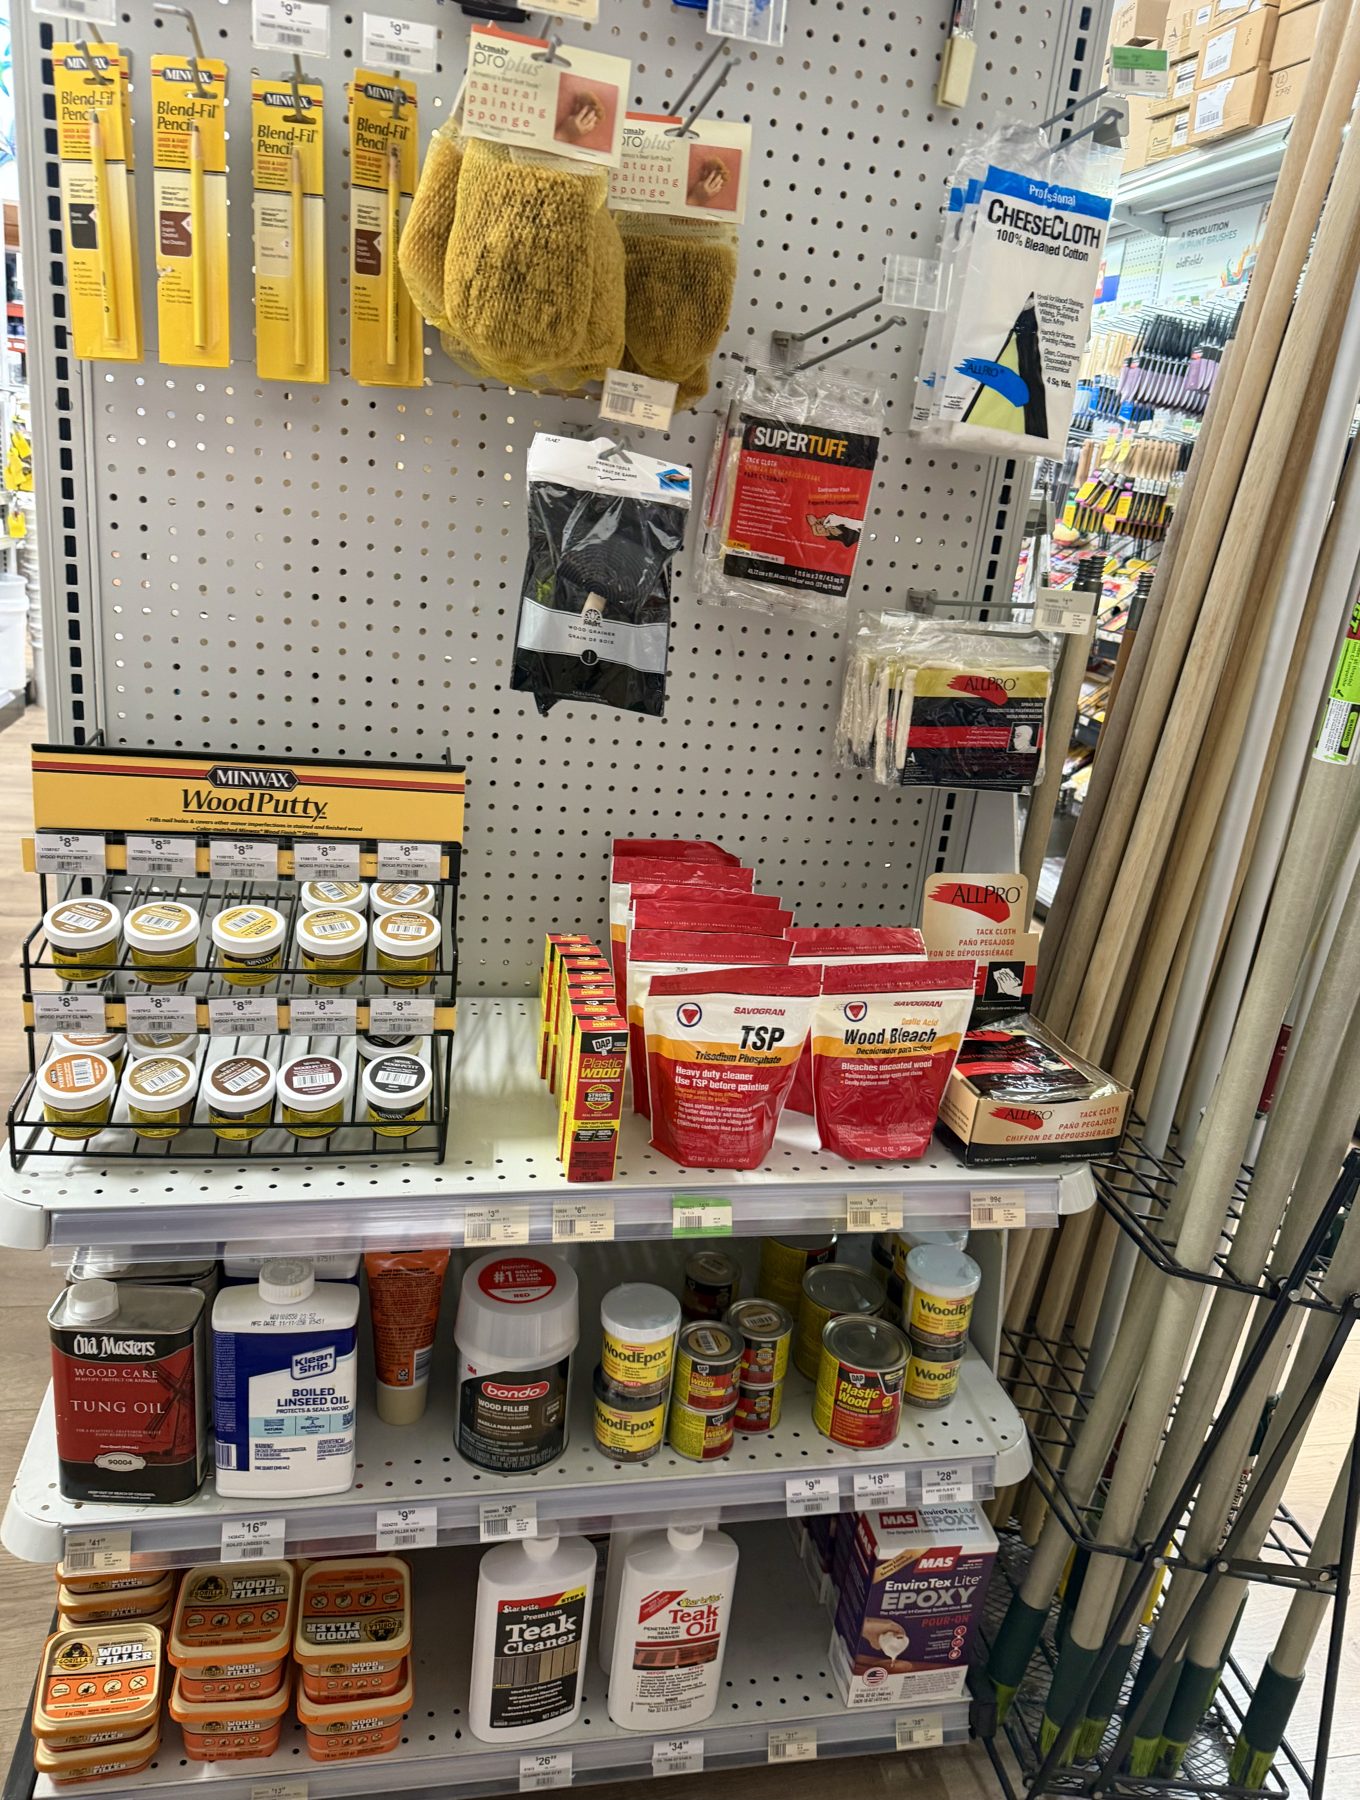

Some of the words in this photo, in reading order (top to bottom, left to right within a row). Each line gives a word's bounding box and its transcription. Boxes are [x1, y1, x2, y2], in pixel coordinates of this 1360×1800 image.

[470, 80, 537, 100] natural
[266, 93, 309, 108] MINWX
[469, 94, 546, 119] painting
[157, 101, 215, 119] Blend-Fil
[467, 108, 530, 128] sponge
[257, 125, 315, 143] Blend-Fil
[357, 118, 407, 140] Blend-Fil
[612, 172, 679, 188] painting
[611, 186, 665, 198] sponge
[753, 427, 848, 460] SUPERTUFF
[216, 770, 290, 788] MINWAX
[951, 885, 1021, 904] ALLPRO
[976, 928, 994, 936] TACK
[996, 928, 1016, 936] CLOTH
[959, 937, 978, 946] PAÑO
[980, 938, 1015, 947] PEGAJOSO
[894, 1000, 942, 1008] SAVOGRAN
[733, 1006, 786, 1016] SAVOGRAN
[739, 1026, 784, 1051] TSP
[844, 1028, 886, 1045] Wood
[889, 1028, 937, 1044] Bleach
[595, 1039, 611, 1050] DAP
[582, 1058, 624, 1069] Plastic
[695, 1051, 736, 1062] Trisodium
[738, 1054, 781, 1066] Phosphate
[842, 1062, 878, 1071] Bleaches
[879, 1062, 912, 1071] uncoated
[914, 1060, 932, 1068] wood
[581, 1068, 621, 1078] WOOD
[676, 1066, 700, 1078] Heavy
[702, 1070, 720, 1080] duty
[722, 1071, 754, 1080] cleaner
[675, 1076, 690, 1084] Use
[692, 1079, 708, 1087] TSP
[710, 1080, 736, 1090] before
[738, 1083, 769, 1092] painting
[1004, 1108, 1053, 1121] ALLPRO
[1080, 1110, 1096, 1120] TACK
[1098, 1106, 1120, 1117] CLOTH
[1059, 1120, 1075, 1130] PAÑO
[1076, 1117, 1118, 1129] PEGAJOSO
[1006, 1134, 1039, 1142] CHIFFON
[1042, 1132, 1053, 1142] DE
[74, 1334, 98, 1354] Old
[98, 1336, 156, 1357] Masters
[294, 1352, 332, 1366] Klean
[74, 1368, 117, 1378] WOOD
[122, 1370, 158, 1379] CARE
[299, 1364, 328, 1374] Strip
[467, 1364, 477, 1376] 3M
[852, 1374, 864, 1382] DAP
[292, 1388, 336, 1397] BOILED
[488, 1385, 540, 1398] bondo
[840, 1381, 880, 1399] Plastic
[277, 1398, 328, 1408] LINSEED
[330, 1396, 350, 1405] OIL
[478, 1399, 502, 1410] WOOD
[839, 1391, 870, 1408] Wood
[70, 1400, 126, 1413] TUNG
[134, 1402, 165, 1414] OIL
[276, 1406, 306, 1414] PROTECTS
[331, 1404, 350, 1412] WOOD
[882, 1513, 916, 1526] MAS
[924, 1514, 977, 1527] EPOXY
[918, 1556, 954, 1569] MAS
[232, 1578, 276, 1590] WOOD
[954, 1576, 980, 1587] Lite
[230, 1586, 285, 1600] FILLER
[881, 1586, 977, 1610] EPOXY
[523, 1608, 562, 1621] Premium
[668, 1604, 720, 1624] Teak
[686, 1618, 717, 1636] Oil
[922, 1614, 968, 1628] POUR-ON
[505, 1614, 576, 1642] Teak
[98, 1644, 144, 1656] WOOD
[503, 1632, 576, 1655] Cleaner
[96, 1652, 152, 1666] FILLER
[227, 1668, 261, 1676] FILLER
[227, 1724, 261, 1732] FILLER
